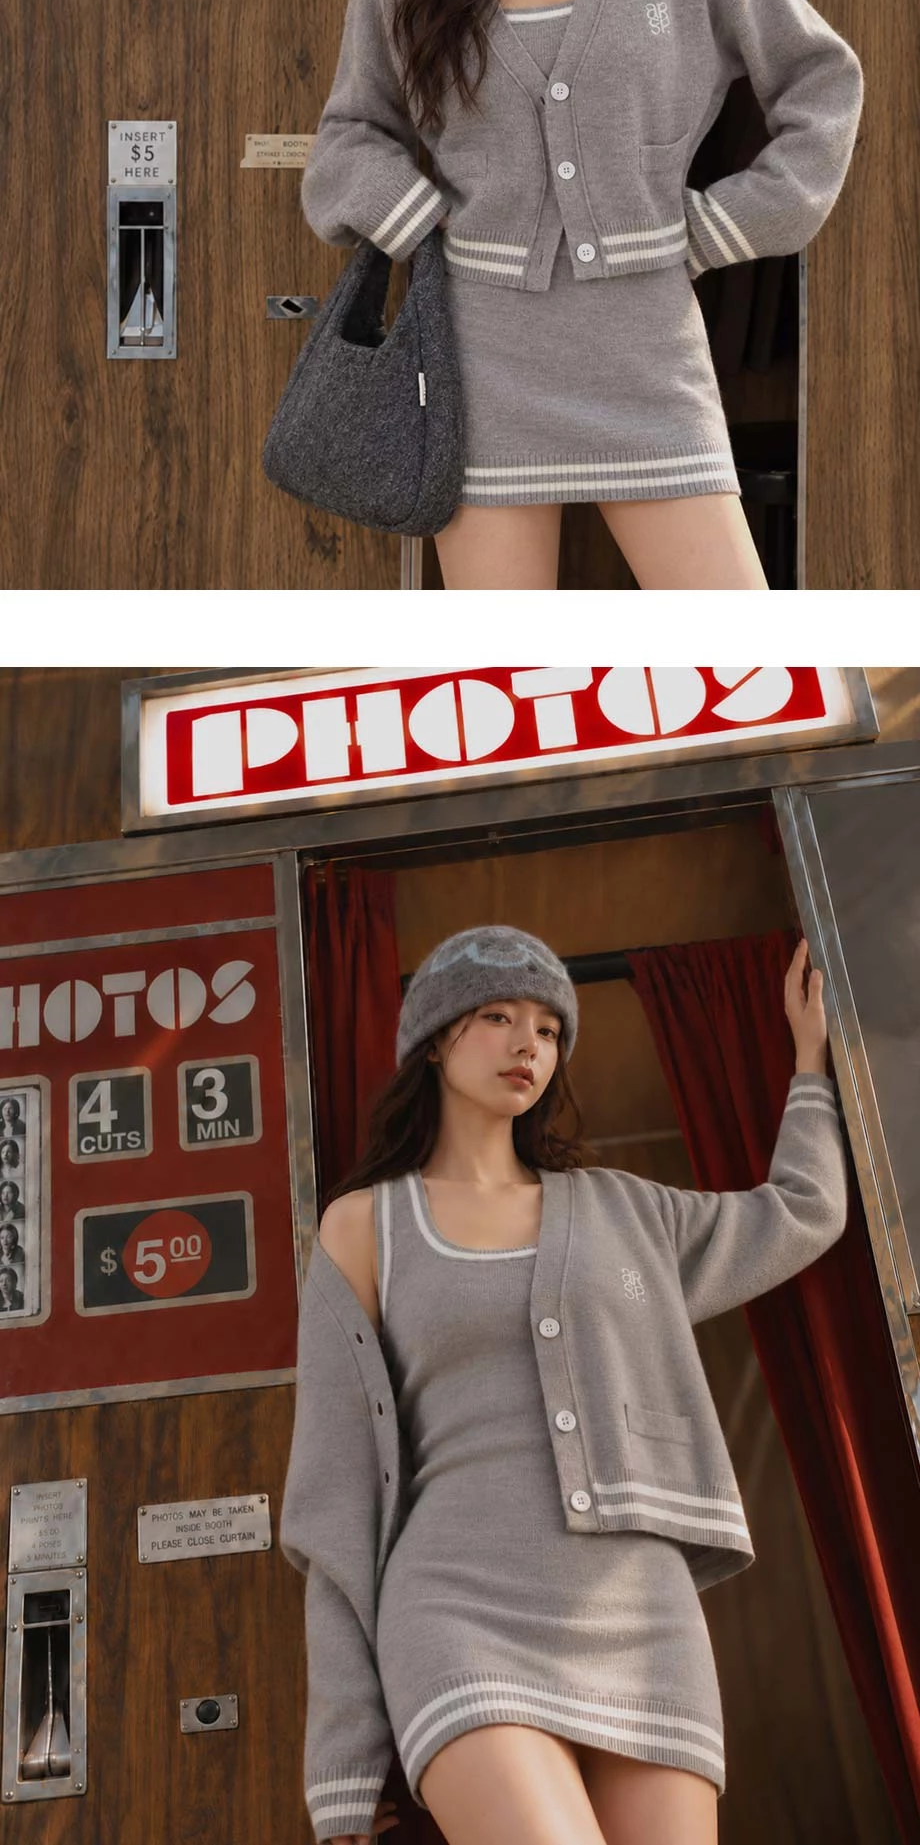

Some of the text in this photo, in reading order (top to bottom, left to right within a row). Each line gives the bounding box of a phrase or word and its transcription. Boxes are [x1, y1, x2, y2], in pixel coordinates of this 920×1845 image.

[120, 132, 166, 142] INSERT
[125, 167, 160, 178] HERE
[192, 667, 793, 797] PHOTOS
[0, 960, 256, 1050] HOTOS
[191, 1068, 229, 1120] 3
[78, 1080, 118, 1134] 4
[197, 1118, 241, 1141] MIN
[80, 1131, 142, 1155] CUTS
[152, 1505, 255, 1523] PHOTOS MAY BE TAKEN
[176, 1520, 232, 1533] INSIDE BOOTH
[151, 1532, 256, 1550] PLEASE CLOSE CURTAIN
